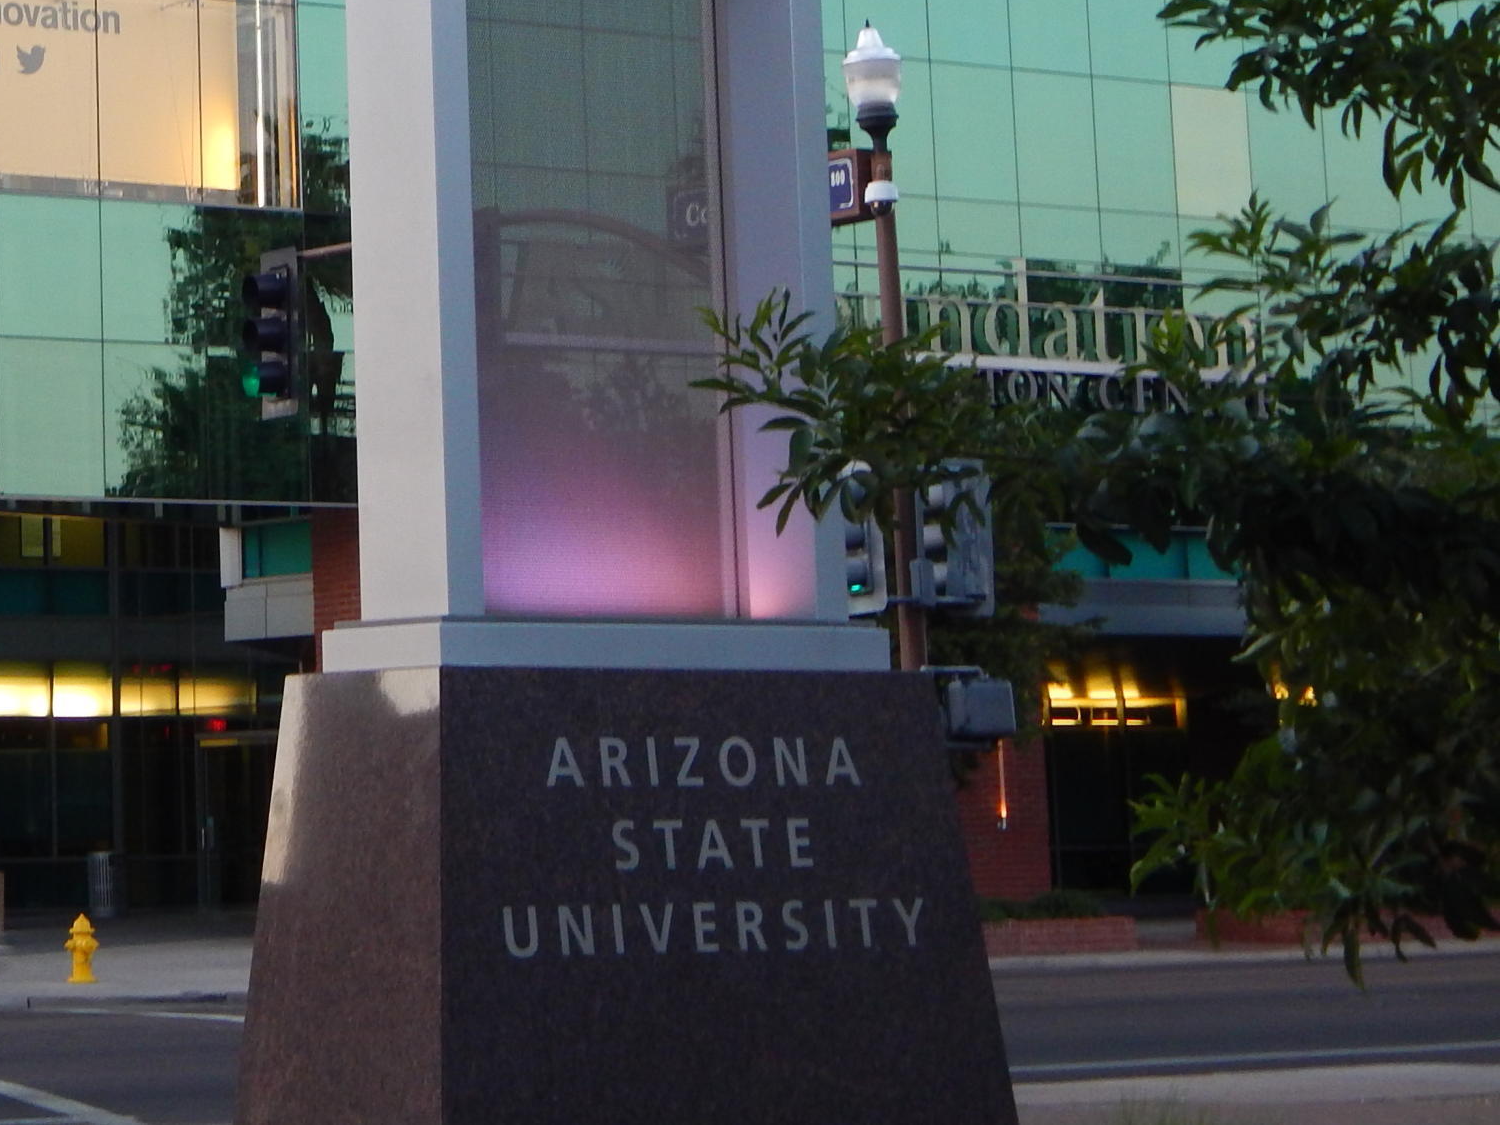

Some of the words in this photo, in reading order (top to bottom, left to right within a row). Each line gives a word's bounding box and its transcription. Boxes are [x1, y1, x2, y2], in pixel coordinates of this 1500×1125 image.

[546, 736, 861, 788] ARIZONA
[612, 817, 814, 871] STATE
[502, 898, 925, 959] UNIVERSITY
